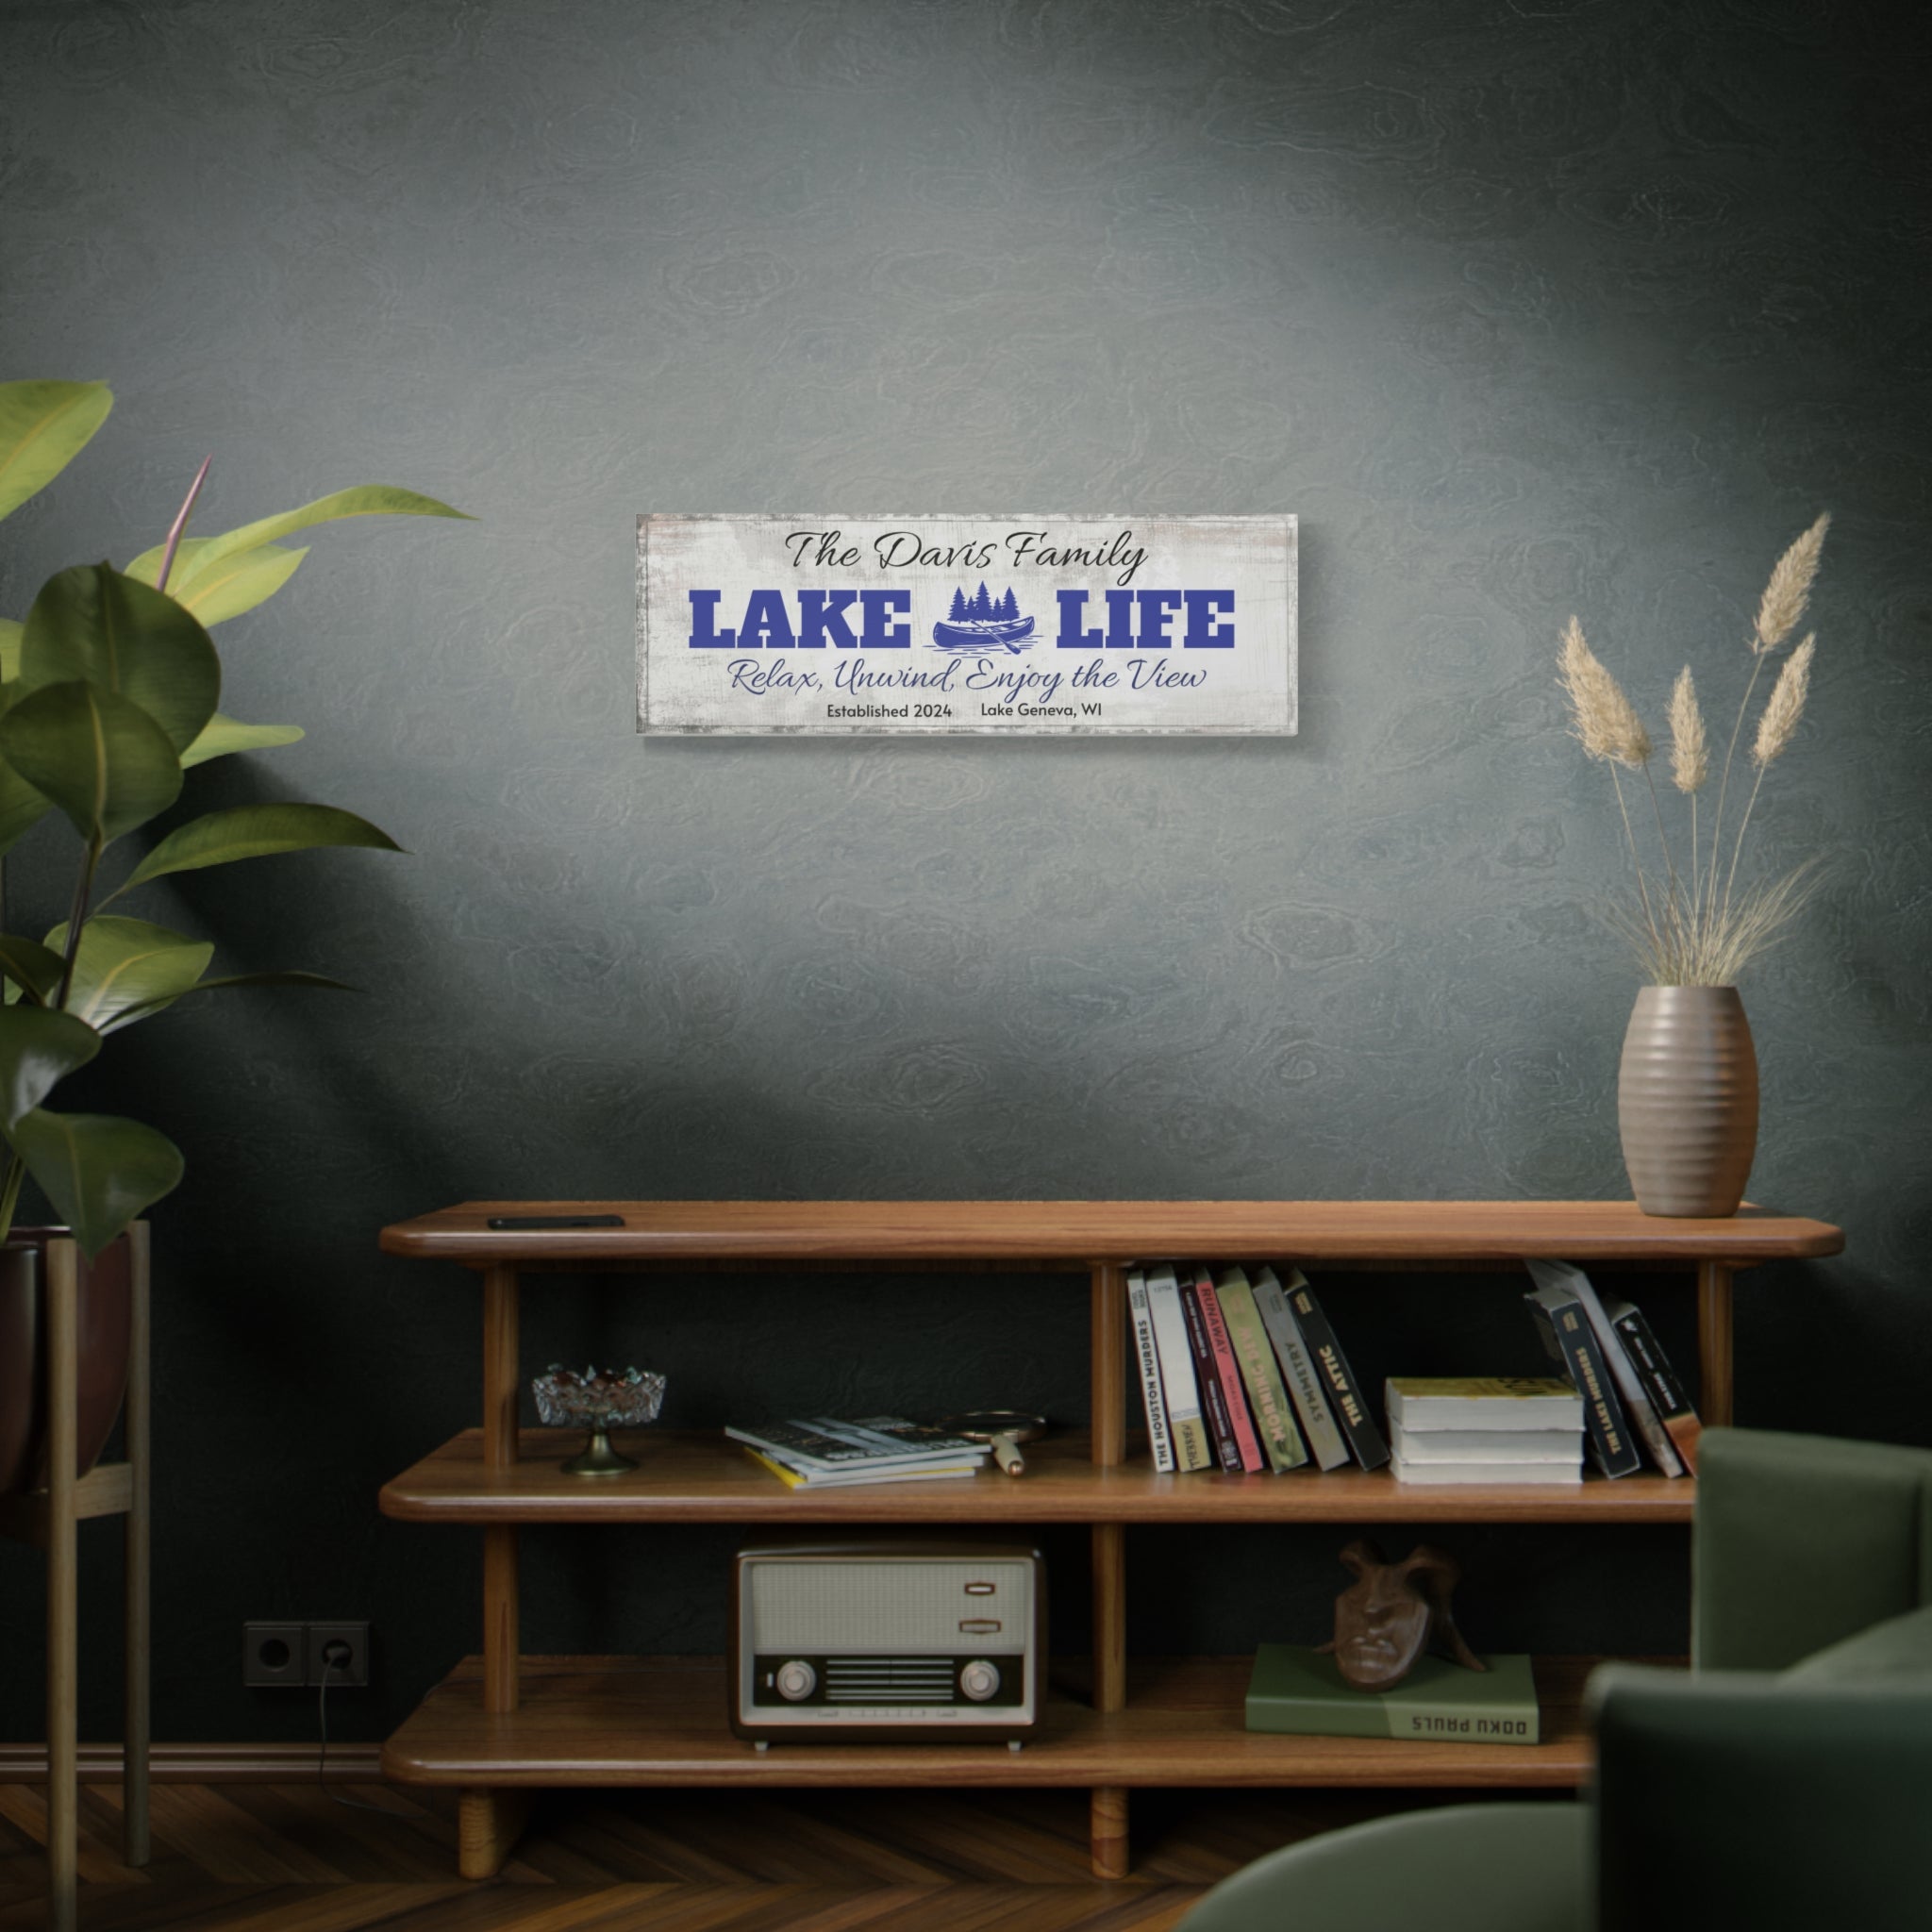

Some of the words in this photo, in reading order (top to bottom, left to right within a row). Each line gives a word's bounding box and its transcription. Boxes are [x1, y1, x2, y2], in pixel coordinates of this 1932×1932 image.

[785, 530, 861, 567] The
[874, 531, 998, 569] Davis
[1005, 530, 1149, 587] Family
[689, 590, 911, 648] LAKE
[1056, 590, 1235, 648] LIFE
[726, 658, 824, 695] Relax,
[833, 658, 961, 695] Unwind,
[965, 658, 1064, 704] Enjoy
[1071, 658, 1121, 689] the
[1126, 658, 1208, 690] View
[827, 704, 908, 718] Established
[913, 704, 953, 718] 2024
[981, 702, 1014, 717] Lake
[1018, 702, 1077, 718] Geneva,
[1081, 702, 1102, 717] WI
[1201, 1289, 1228, 1355] RUNAWAY
[1138, 1320, 1156, 1378] MURDERS
[1319, 1345, 1349, 1391] ATTIC
[1575, 1346, 1603, 1401] MURDERS
[1252, 1364, 1286, 1441] MORNING
[1286, 1341, 1324, 1423] SYMMETRY
[1146, 1380, 1165, 1440] HOUSTON
[1341, 1394, 1363, 1427] THE
[1156, 1443, 1169, 1466] THE
[1606, 1431, 1622, 1456] THE
[1411, 1716, 1470, 1733] PAULS
